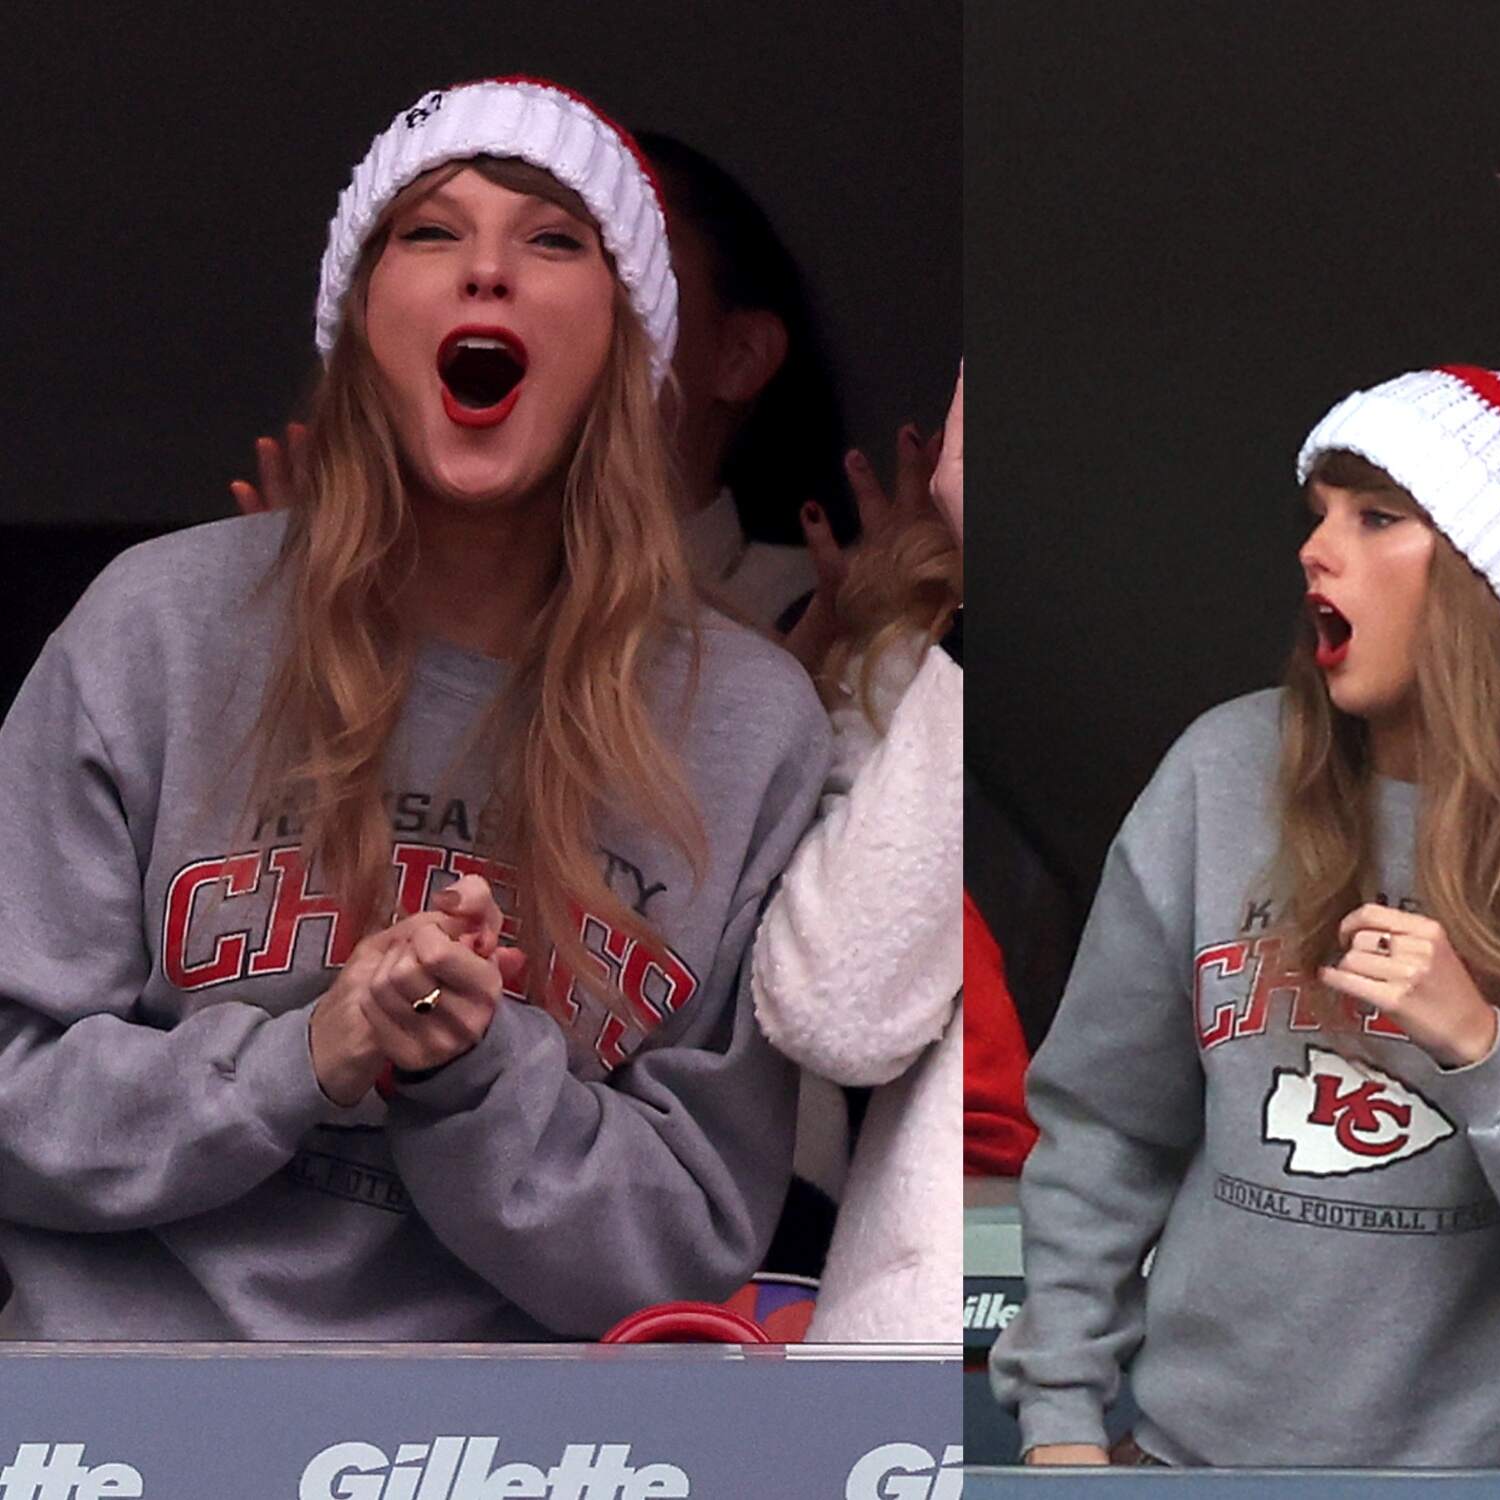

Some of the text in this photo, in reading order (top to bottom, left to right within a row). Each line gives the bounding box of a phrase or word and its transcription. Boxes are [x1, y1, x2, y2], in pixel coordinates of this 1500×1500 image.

[1307, 1074, 1412, 1156] KC
[1217, 1179, 1290, 1215] TIONAL
[1301, 1202, 1426, 1230] FOOTBALL
[299, 1436, 690, 1500] Gillette
